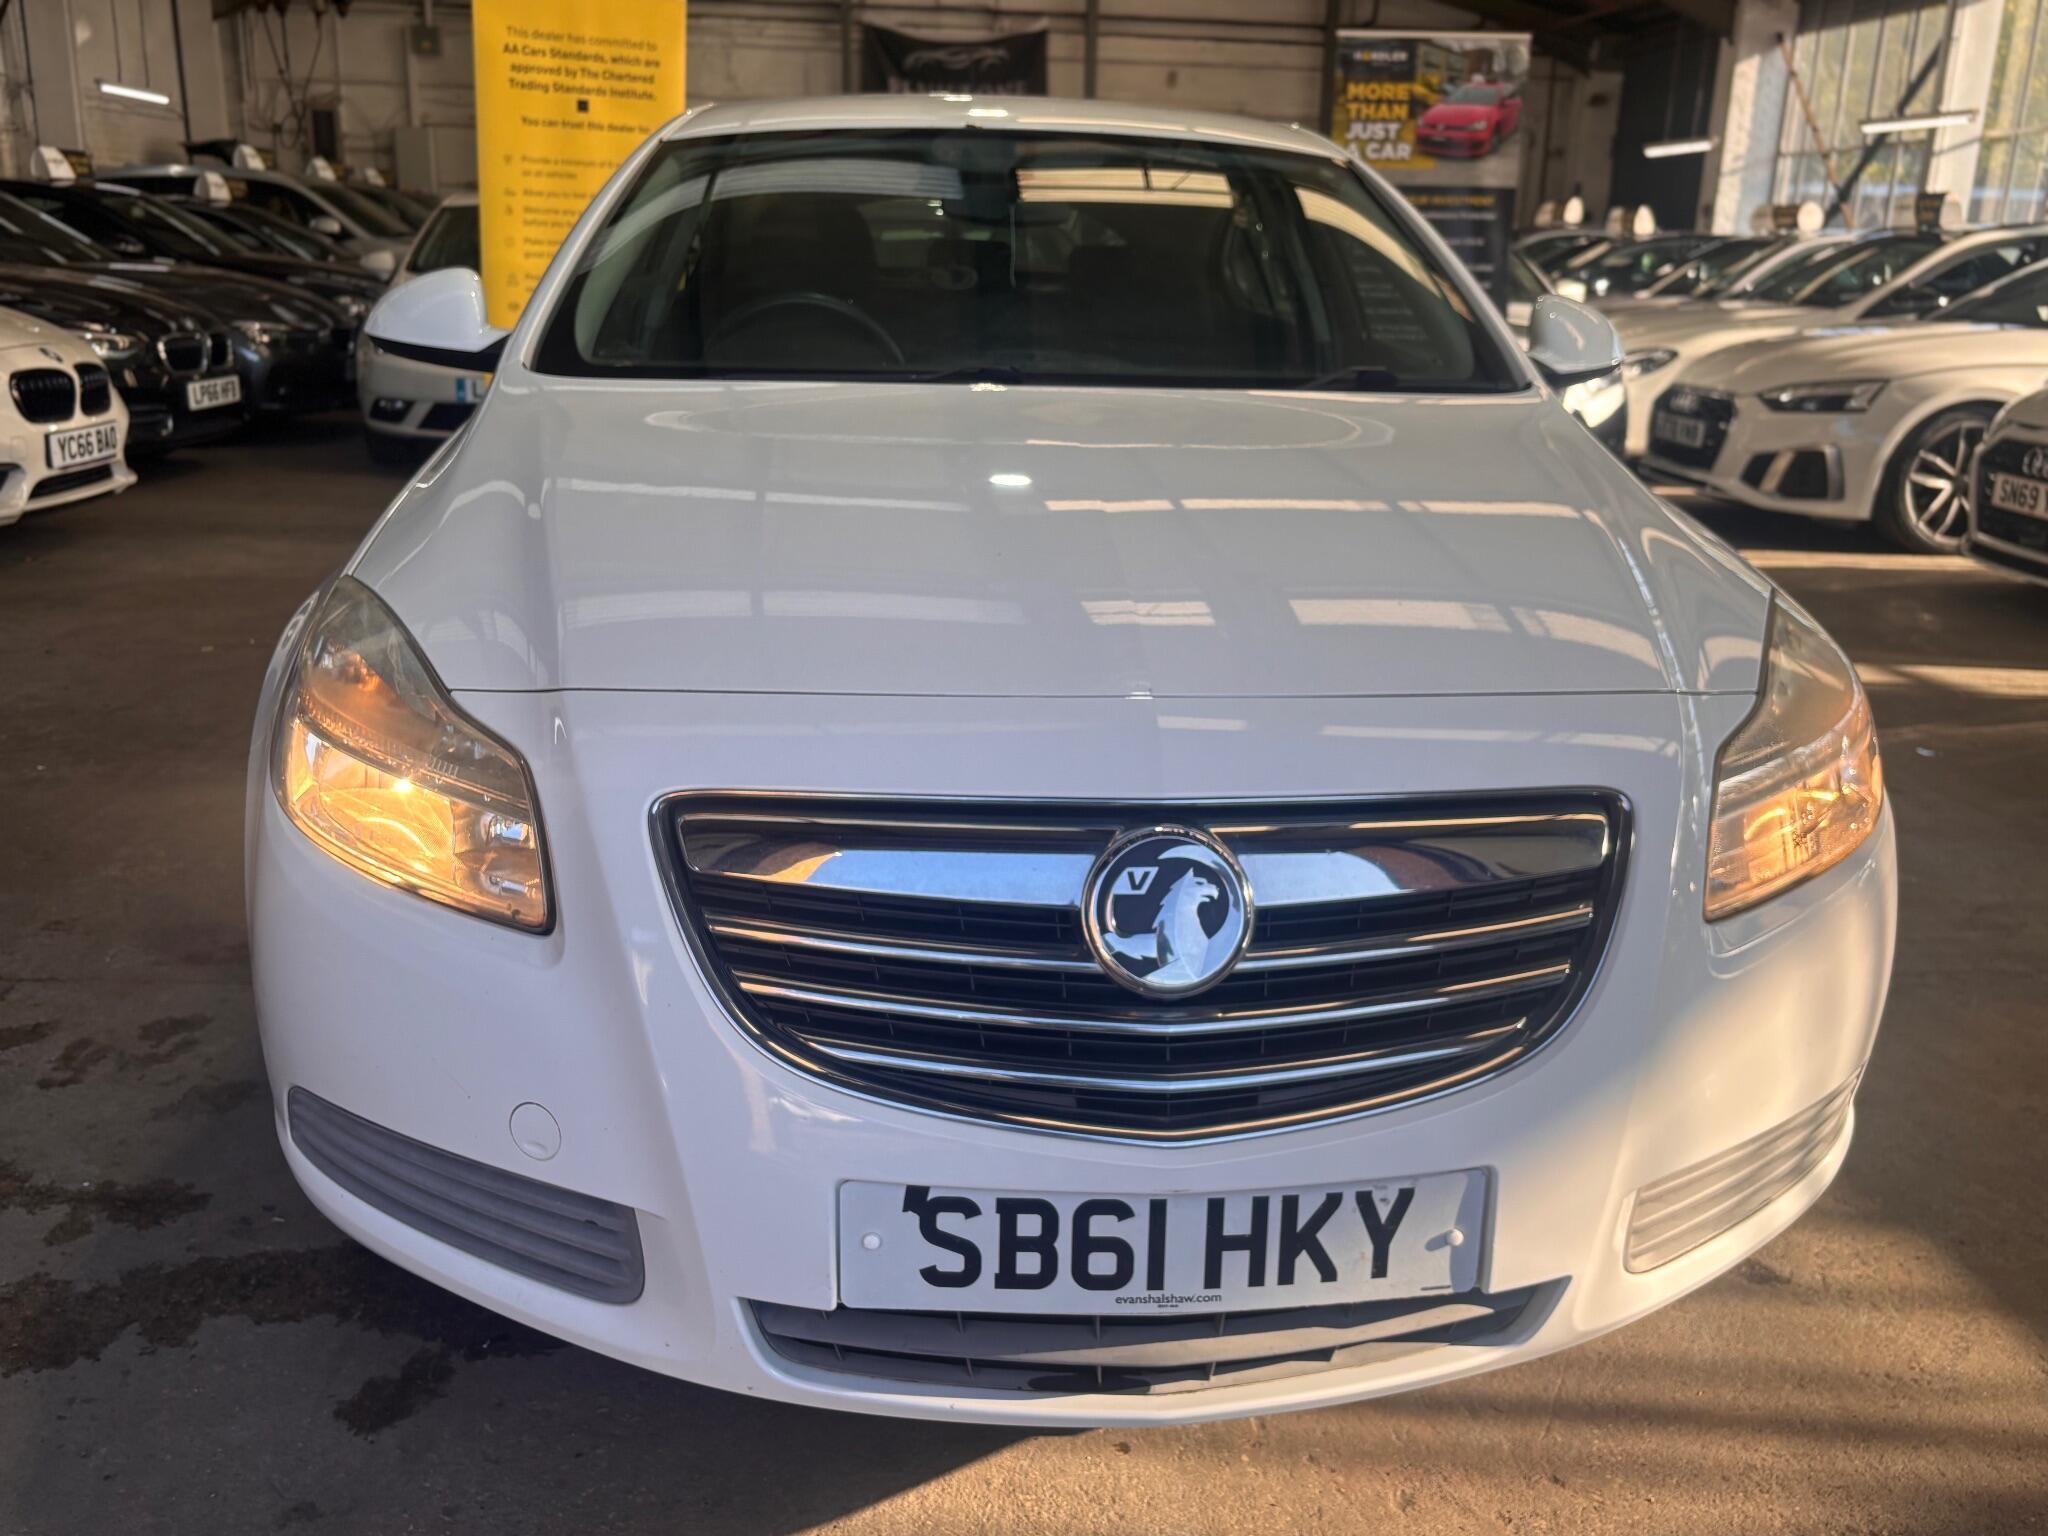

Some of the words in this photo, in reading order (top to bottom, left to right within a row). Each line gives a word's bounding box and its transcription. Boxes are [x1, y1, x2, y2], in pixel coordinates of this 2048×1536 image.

[502, 42, 519, 54] AA
[522, 44, 547, 57] Cars
[550, 47, 608, 64] Standards,
[610, 53, 641, 66] which
[644, 57, 660, 68] are
[510, 61, 563, 77] approved
[565, 66, 578, 79] by
[580, 67, 599, 80] The
[602, 69, 655, 84] Chartered
[508, 77, 549, 93] Trading
[552, 82, 607, 97] Standards
[1347, 82, 1409, 100] MORE
[1346, 103, 1409, 120] THAN
[1345, 122, 1401, 140] JUST
[1345, 142, 1360, 160] A
[1365, 142, 1412, 160] CAR
[57, 430, 95, 463] YC66
[2000, 478, 2040, 510] SN69
[918, 1194, 1168, 1291] SB61
[1203, 1187, 1415, 1290] HKY
[1115, 1293, 1222, 1305] evanshalshaw.com
